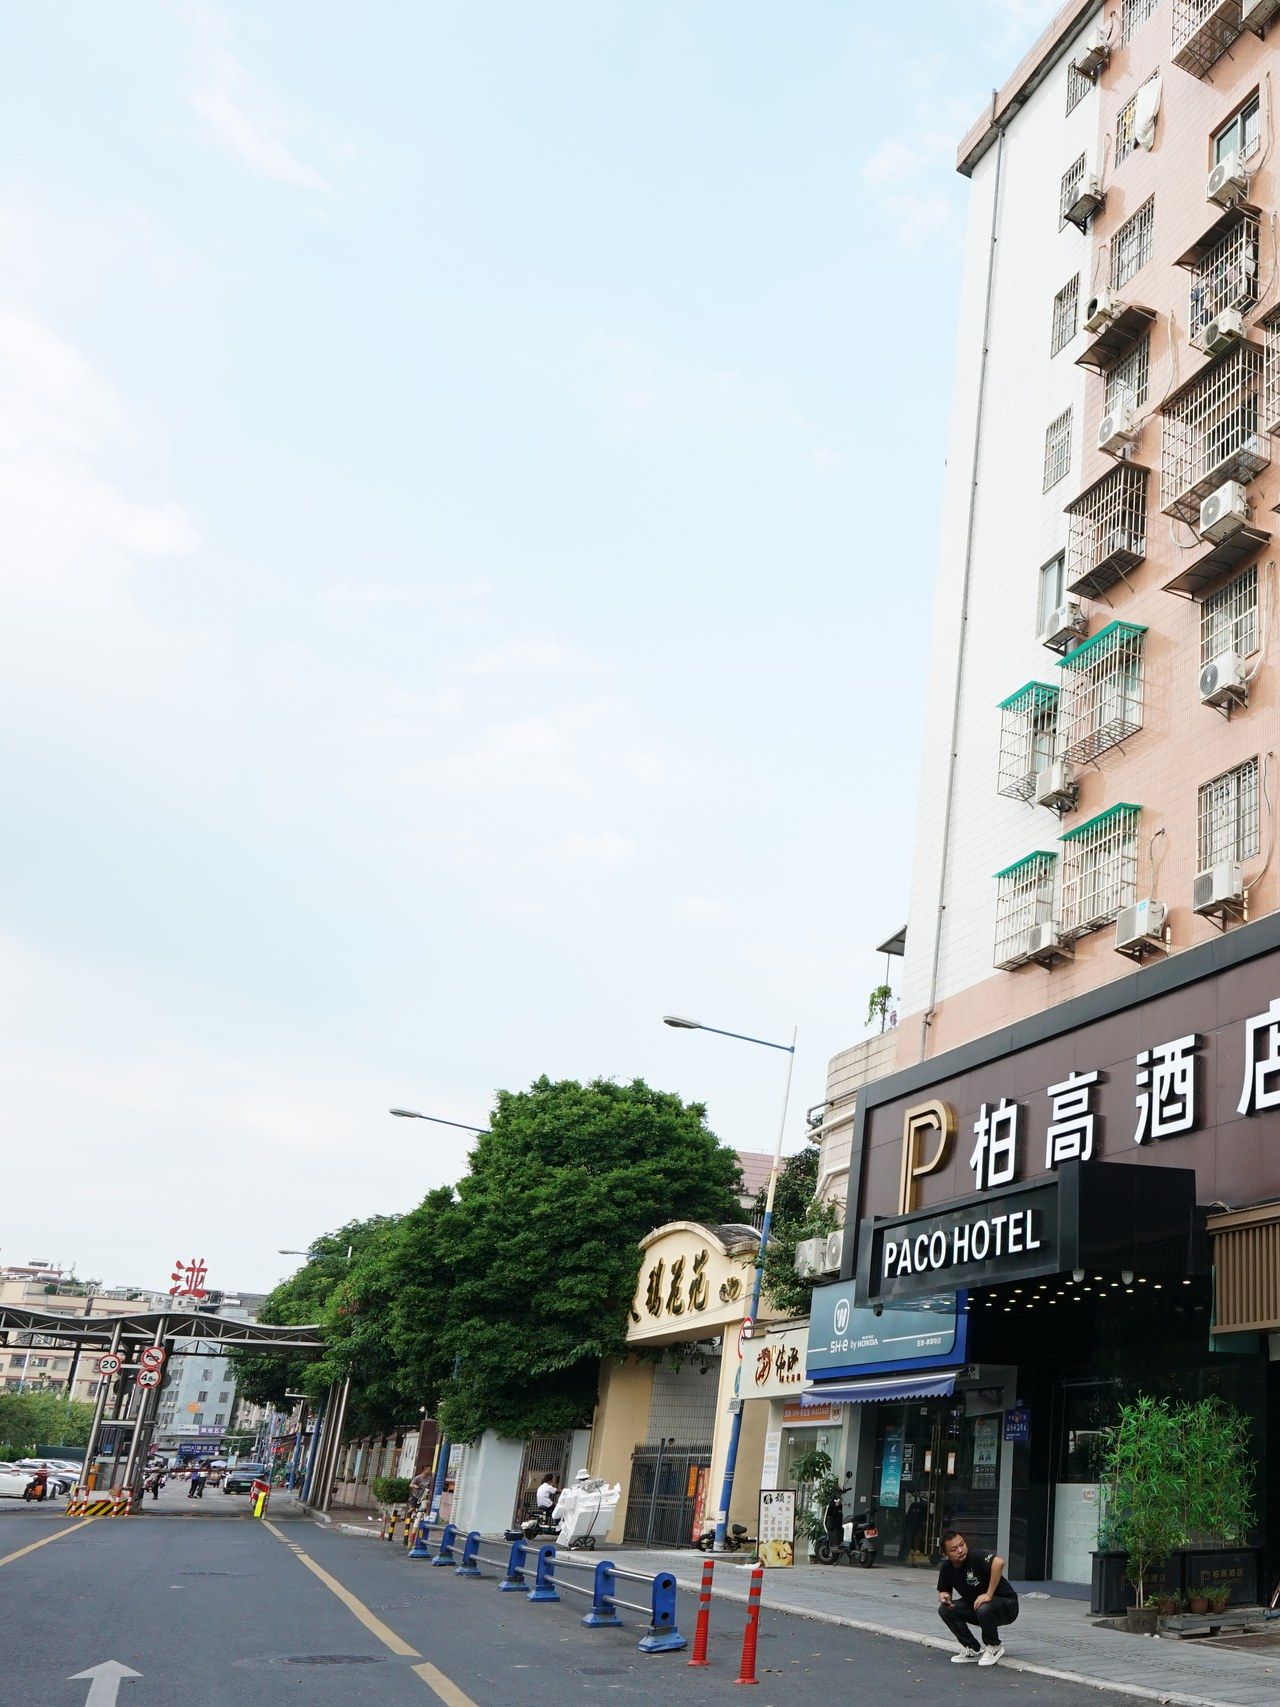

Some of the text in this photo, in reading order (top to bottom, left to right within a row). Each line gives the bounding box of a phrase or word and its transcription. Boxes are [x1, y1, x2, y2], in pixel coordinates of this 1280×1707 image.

[883, 1209, 1041, 1279] PACO HOTEL
[850, 1340, 858, 1350] by
[857, 1338, 879, 1348] HONDA
[102, 1360, 117, 1369] 20
